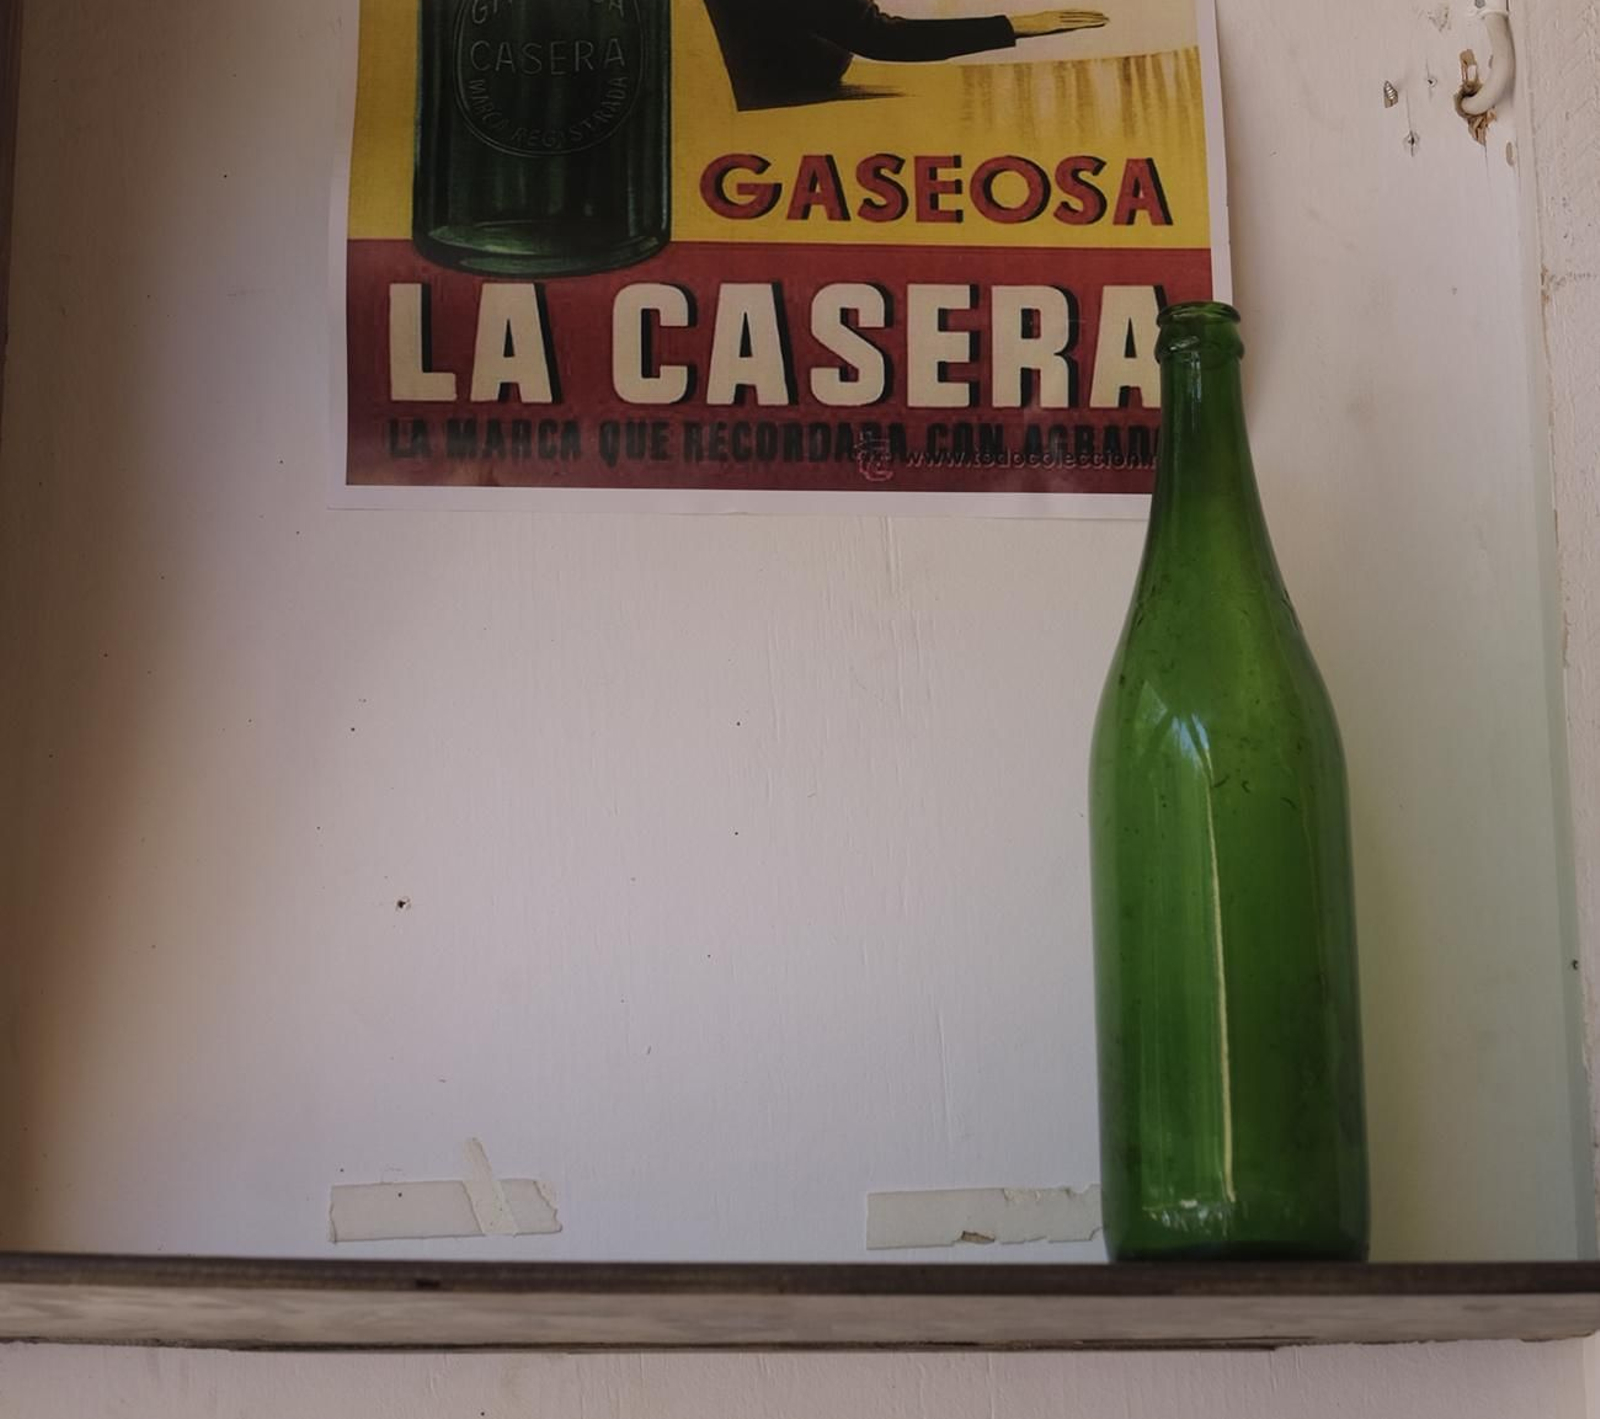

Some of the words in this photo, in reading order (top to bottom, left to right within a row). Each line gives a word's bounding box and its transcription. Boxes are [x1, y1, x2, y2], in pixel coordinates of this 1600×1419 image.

[469, 37, 627, 77] CASERA
[699, 152, 1174, 227] GASEOSA
[388, 282, 563, 405] LA
[611, 281, 1168, 410] CASERA
[387, 416, 432, 460] LA
[443, 416, 583, 463] MARCA
[599, 419, 673, 468] QUE
[926, 421, 1004, 466] CON
[1023, 422, 1160, 468] AGRAD
